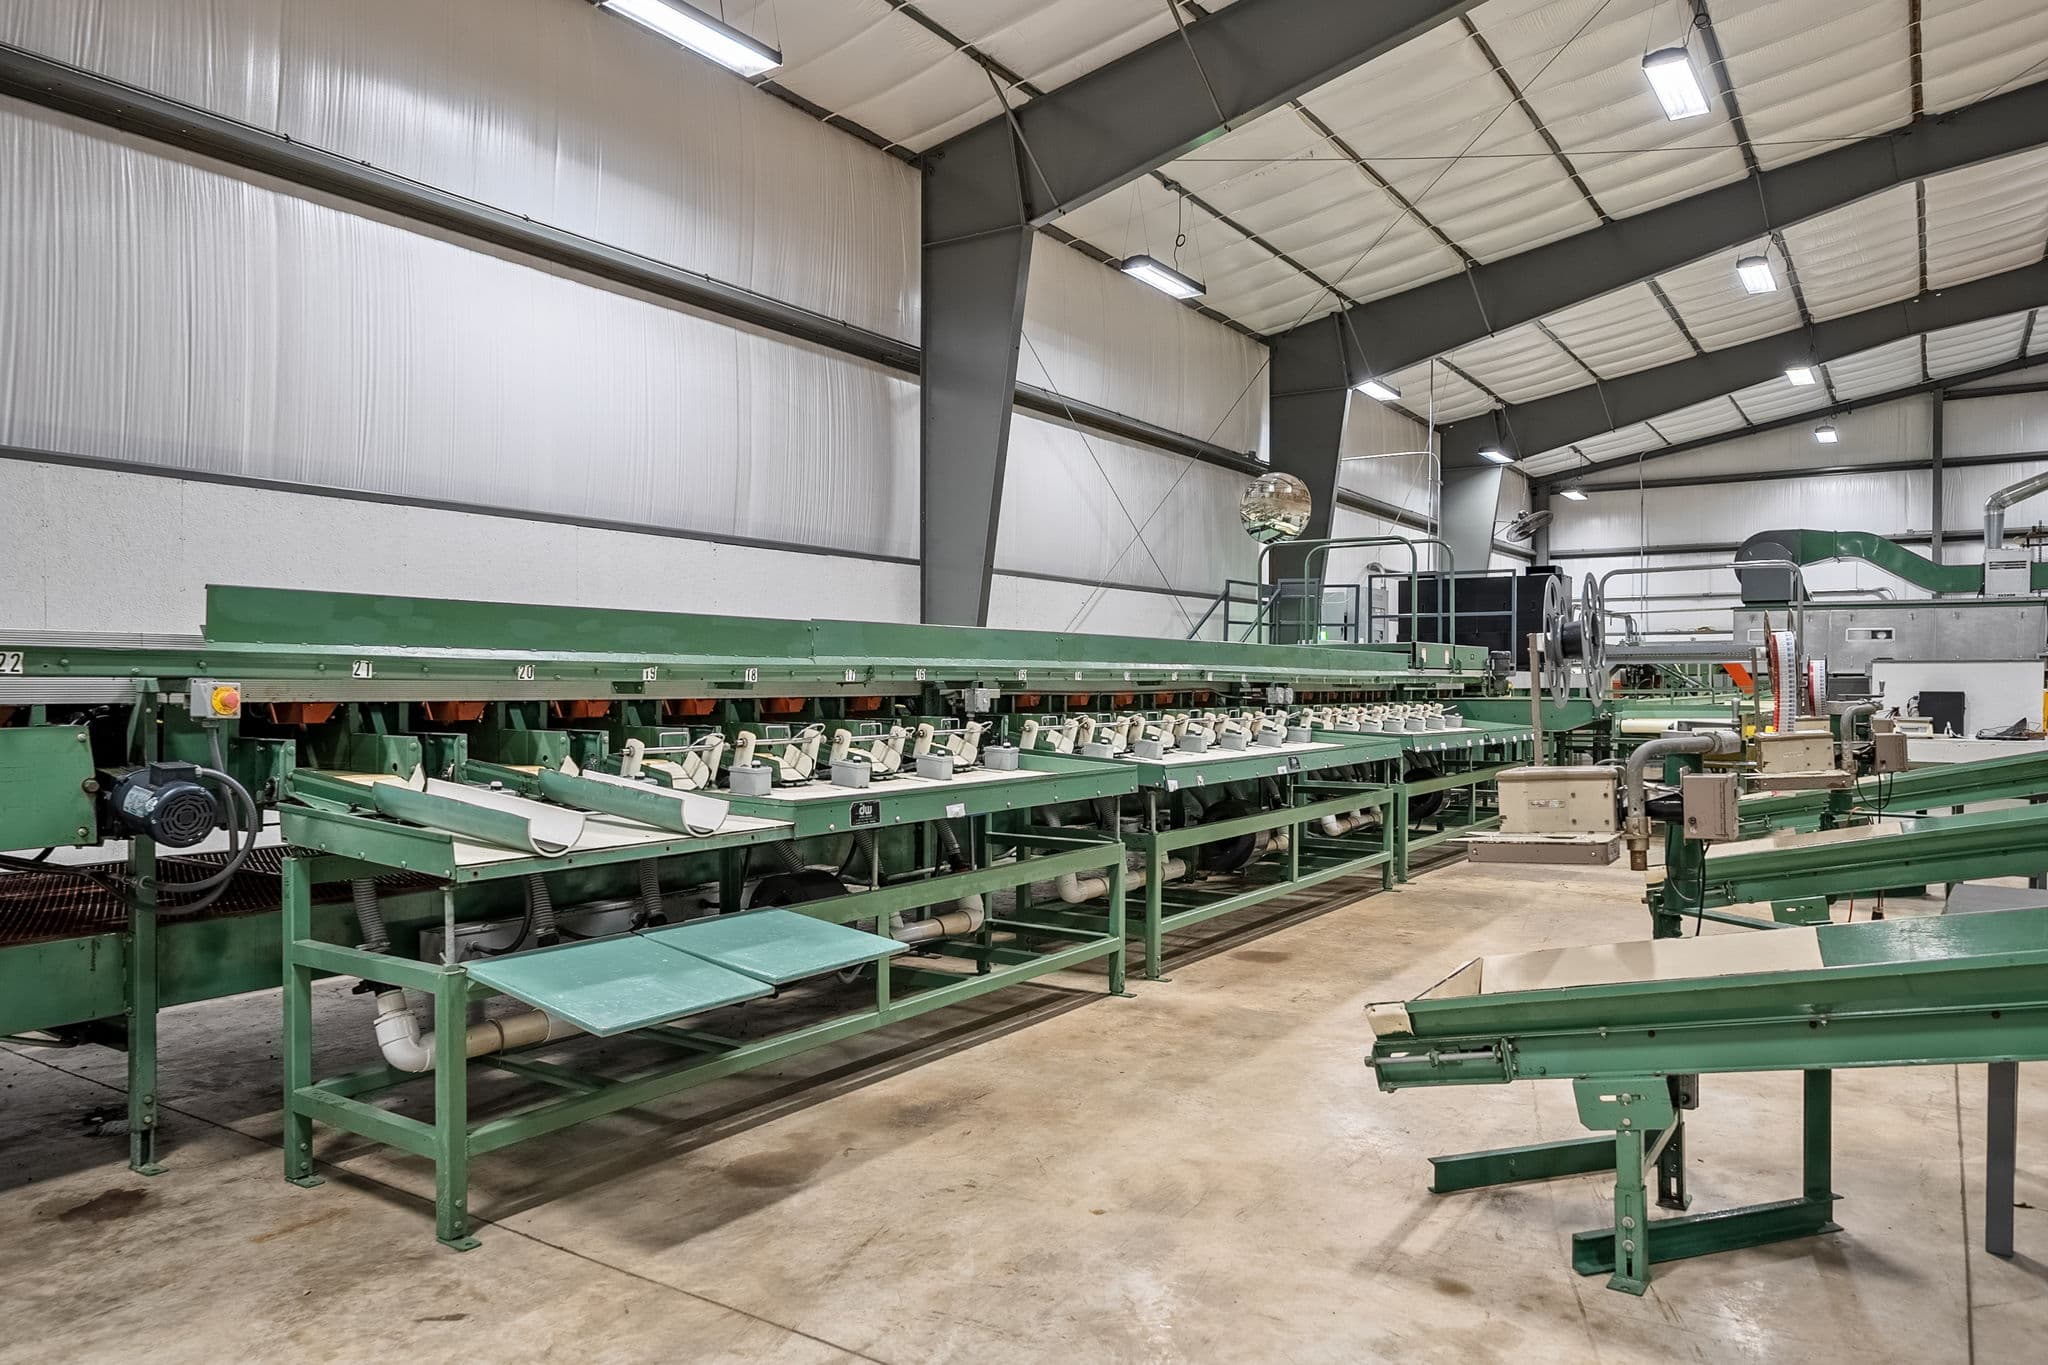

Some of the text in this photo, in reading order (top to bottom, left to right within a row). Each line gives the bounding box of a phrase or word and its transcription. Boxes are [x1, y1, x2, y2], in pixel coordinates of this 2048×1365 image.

[0, 653, 20, 672] 22
[354, 660, 370, 677] 21
[519, 664, 533, 679] 20
[645, 667, 656, 680] 19
[747, 669, 757, 681] 18
